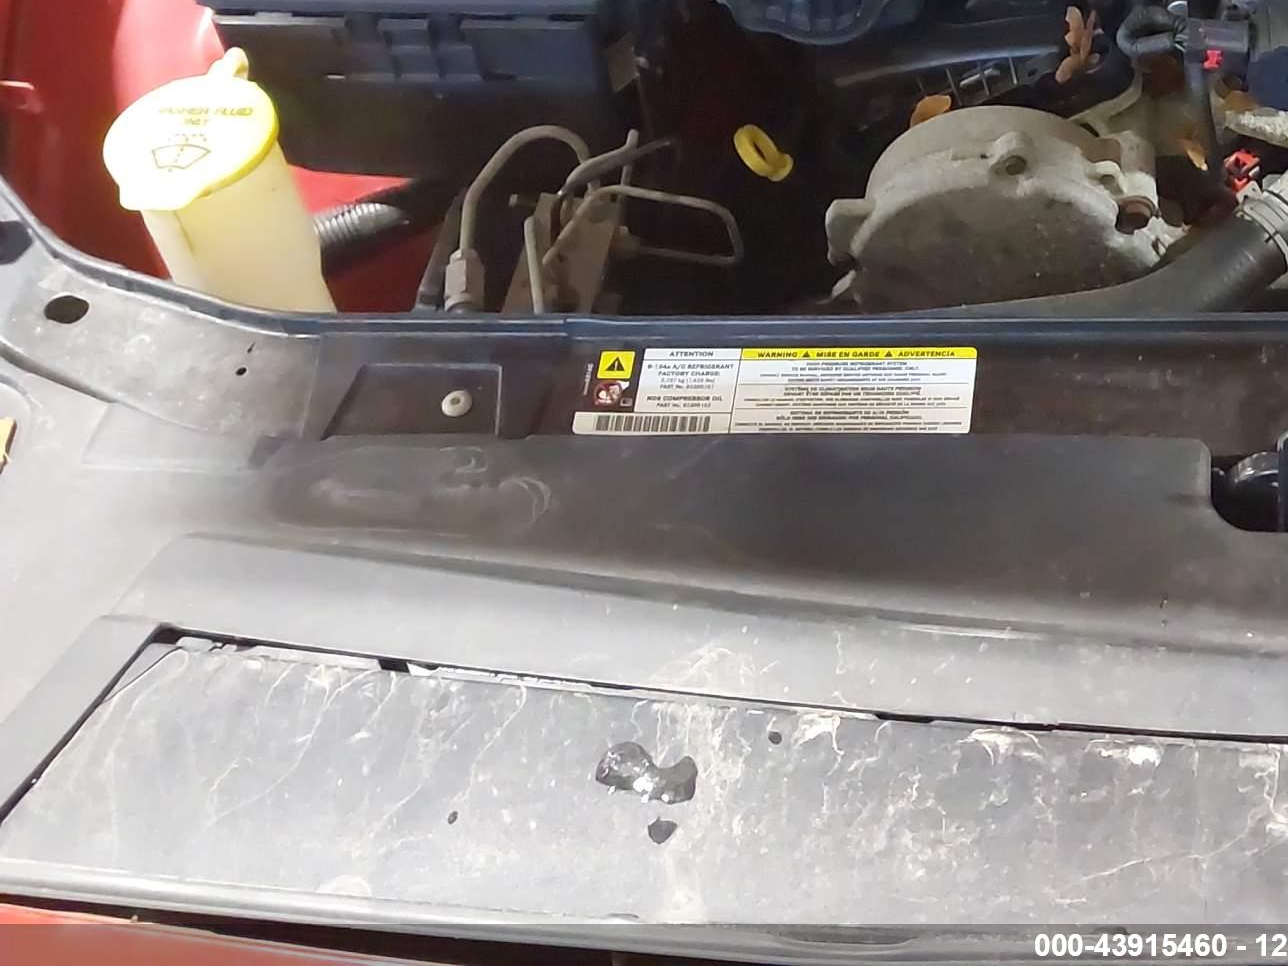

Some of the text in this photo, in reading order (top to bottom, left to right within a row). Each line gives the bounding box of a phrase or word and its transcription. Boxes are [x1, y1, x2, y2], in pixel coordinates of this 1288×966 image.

[756, 350, 798, 358] WARNING
[815, 350, 837, 358] MISE
[837, 350, 850, 358] EN
[851, 350, 880, 358] GARDE
